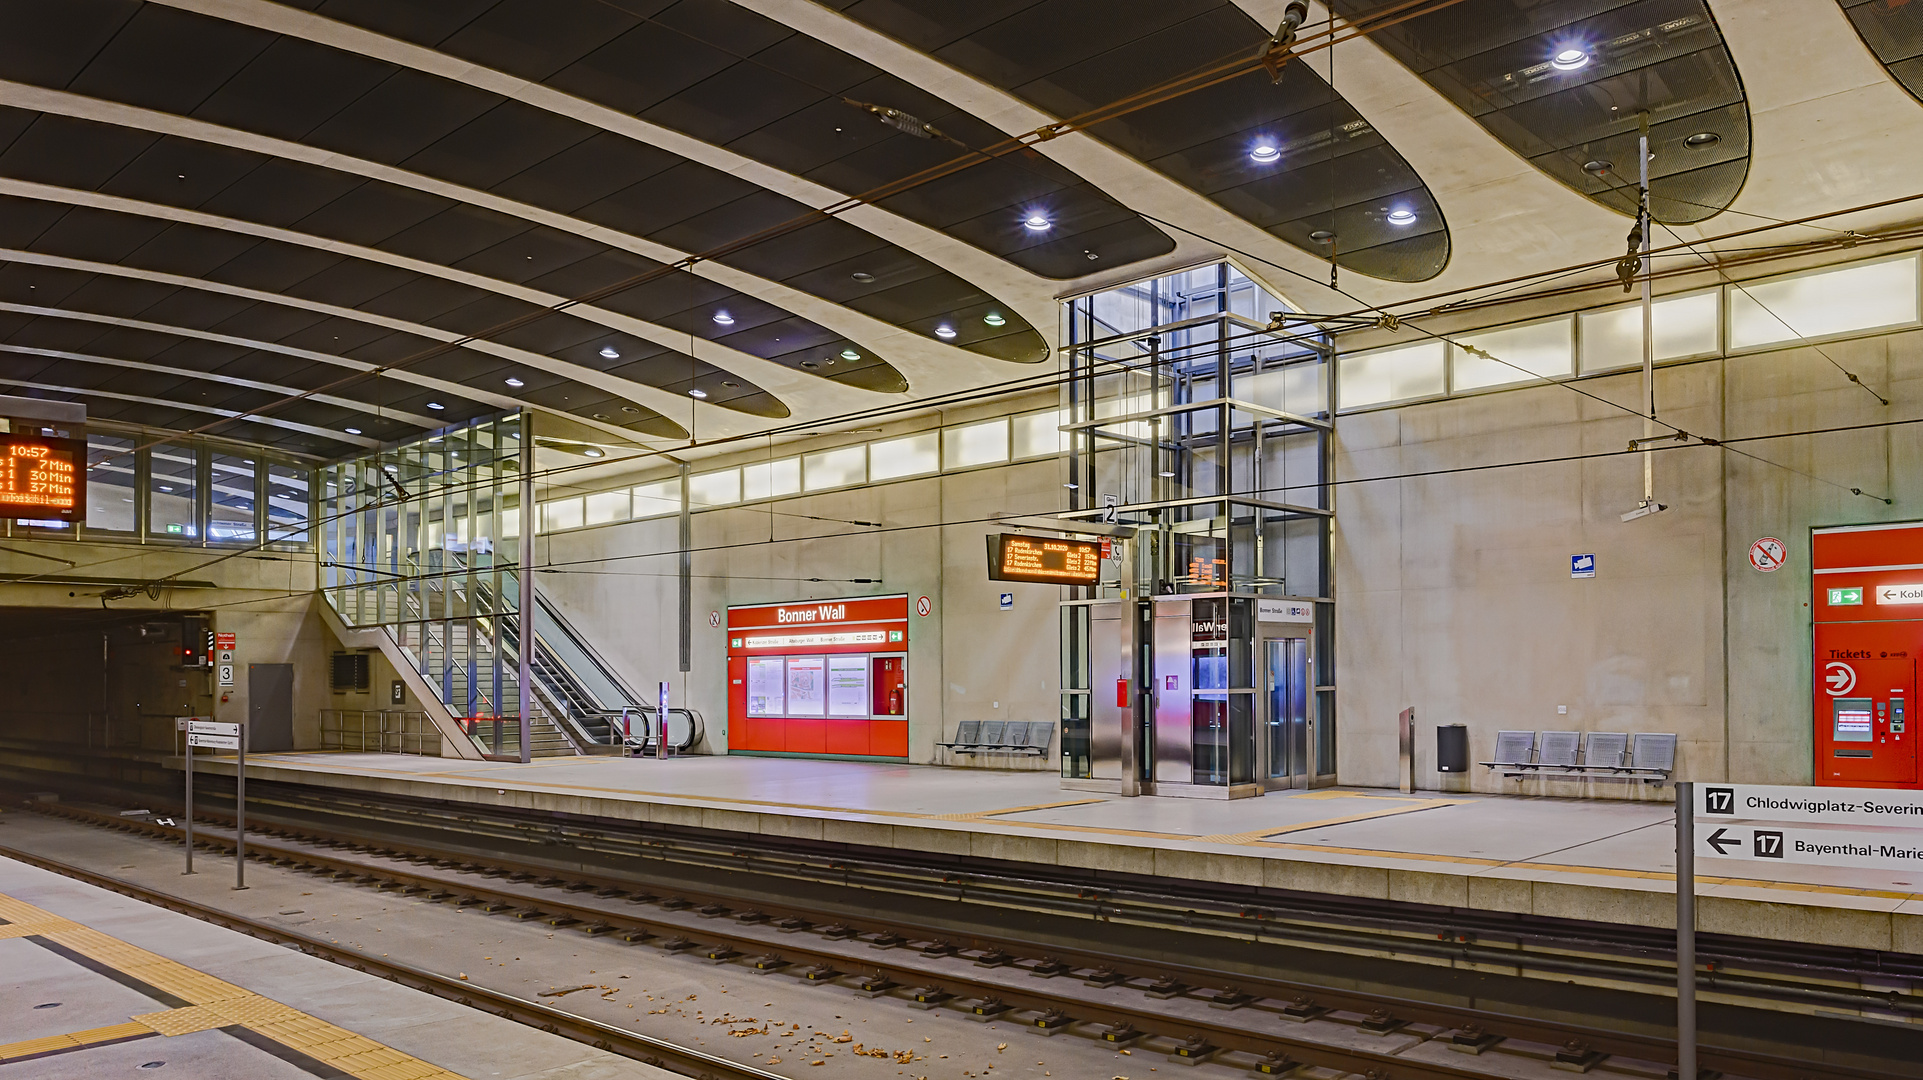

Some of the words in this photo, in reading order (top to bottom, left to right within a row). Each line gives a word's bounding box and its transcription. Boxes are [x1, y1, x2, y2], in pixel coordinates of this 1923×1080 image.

[10, 445, 49, 458] 10:57
[8, 457, 15, 467] 1
[39, 460, 48, 470] 7
[49, 461, 72, 472] Min
[8, 469, 15, 479] 1
[30, 470, 47, 481] 30
[49, 472, 72, 483] Min
[8, 481, 14, 491] 1
[30, 482, 47, 493] 37
[49, 484, 72, 494] Min
[1106, 504, 1115, 522] 2
[1011, 540, 1030, 549] Samstag
[1014, 547, 1043, 556] Rodenkirchen
[777, 608, 817, 623] Bonner
[818, 604, 846, 620] Wall
[1829, 649, 1872, 659] Tickets
[222, 667, 231, 680] 3
[1708, 791, 1732, 811] 17
[1746, 796, 1923, 816] Chlodwigplatz-Severin
[1756, 834, 1781, 854] 17
[1795, 840, 1923, 859] Bayenthal-Marie
